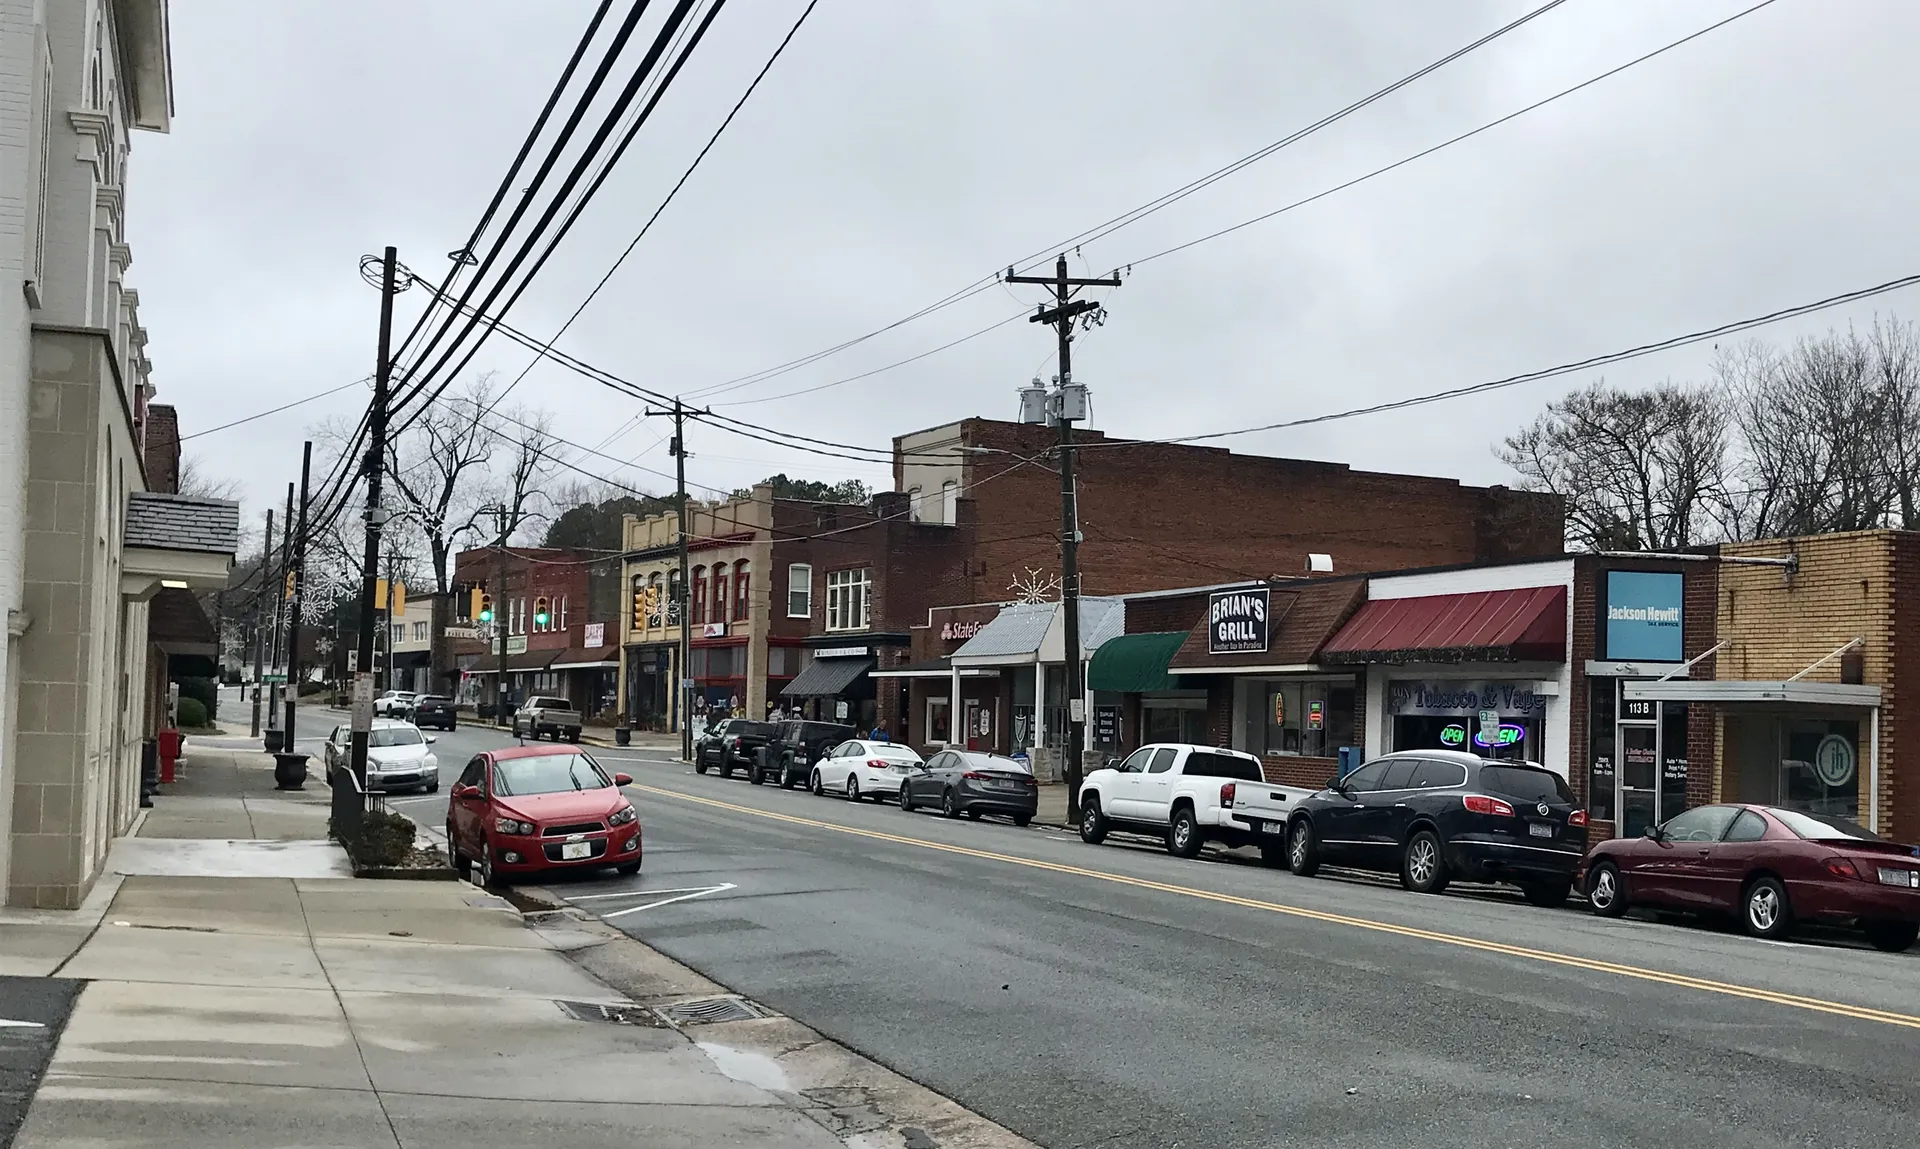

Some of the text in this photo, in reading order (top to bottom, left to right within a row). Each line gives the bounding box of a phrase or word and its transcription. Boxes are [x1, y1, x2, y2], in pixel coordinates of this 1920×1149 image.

[1212, 595, 1265, 624] BRIAN'S
[1608, 605, 1679, 622] Jackson Hewitt
[953, 622, 974, 639] State
[1218, 620, 1256, 642] GRILL
[1414, 684, 1478, 709] Tobacco
[1481, 684, 1498, 709] &
[1629, 702, 1650, 714] 113 B
[1481, 713, 1487, 721] 2
[1443, 727, 1465, 743] OPEN
